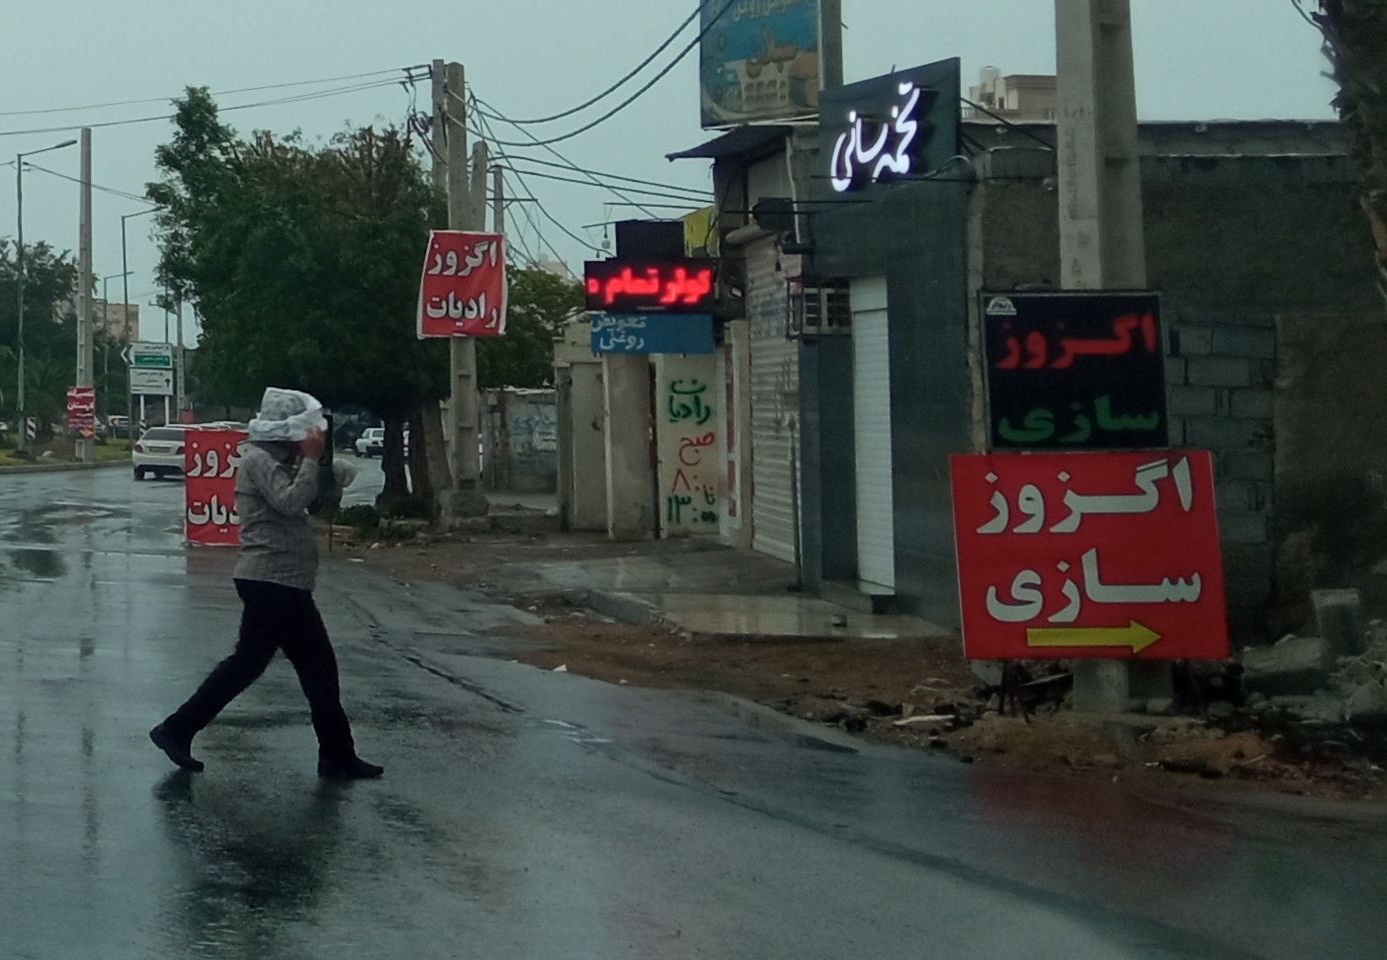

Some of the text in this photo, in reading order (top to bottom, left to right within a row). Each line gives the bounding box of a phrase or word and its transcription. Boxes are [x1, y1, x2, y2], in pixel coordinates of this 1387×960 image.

[427, 240, 497, 276] اگزوز
[427, 290, 498, 328] رادیات
[590, 314, 647, 332] تعویض
[998, 394, 1159, 442] سازی
[679, 431, 715, 466] صبح
[976, 456, 1193, 534] اگزوز
[985, 547, 1201, 622] سازی
